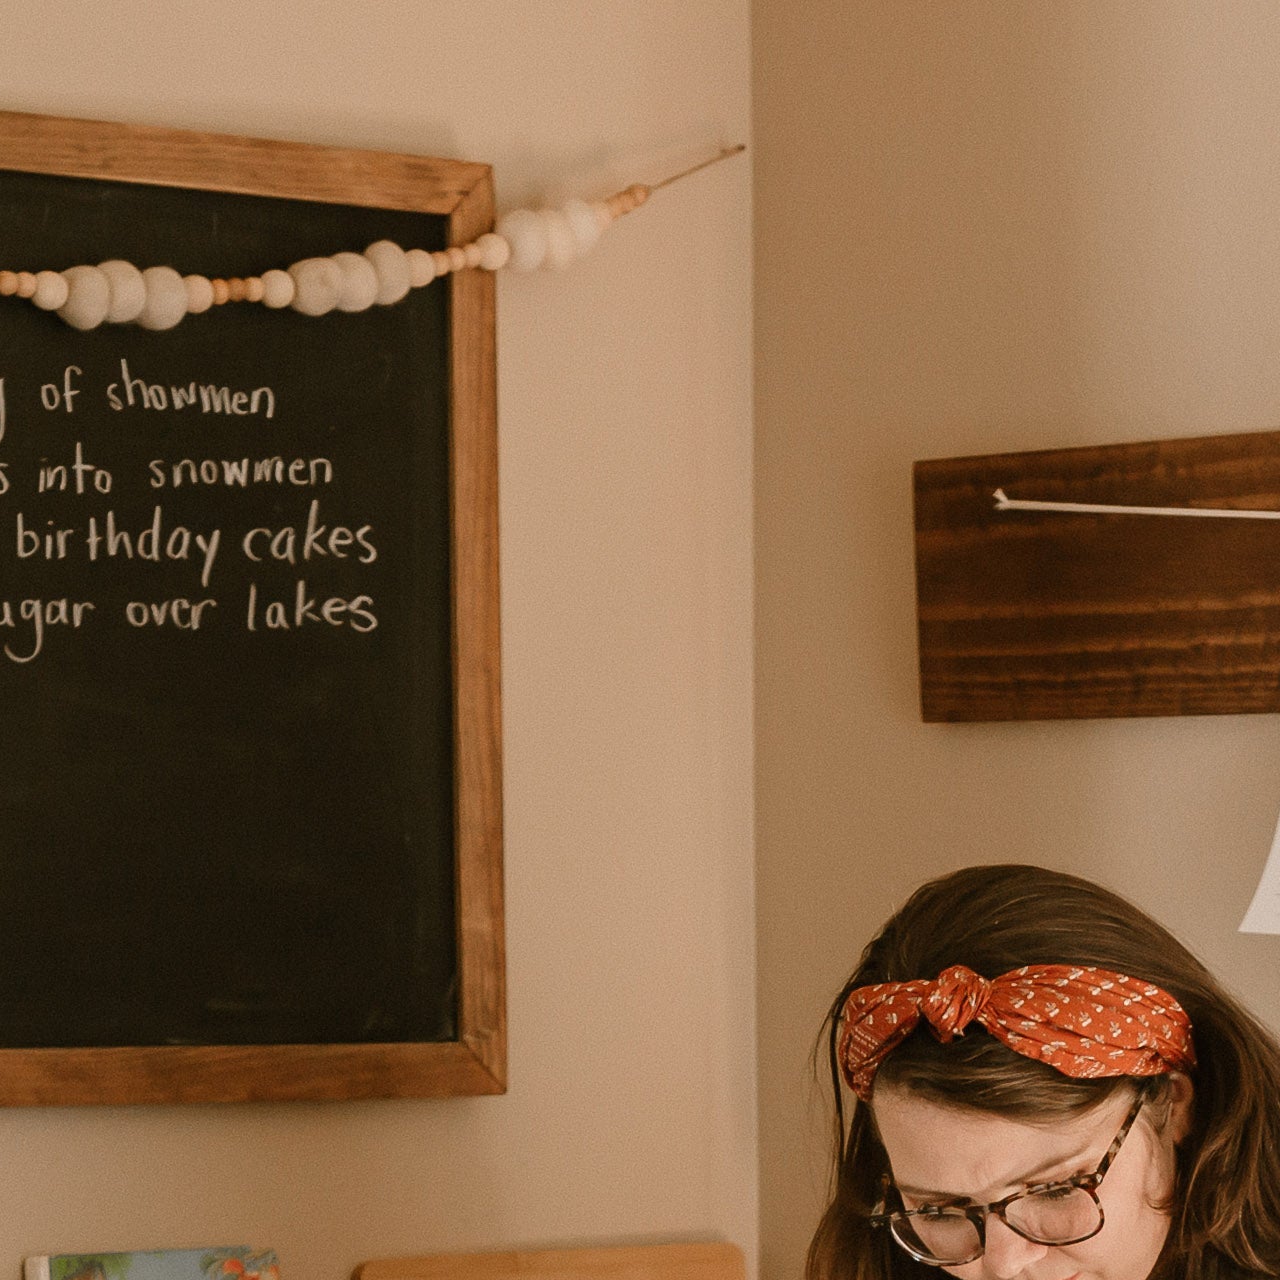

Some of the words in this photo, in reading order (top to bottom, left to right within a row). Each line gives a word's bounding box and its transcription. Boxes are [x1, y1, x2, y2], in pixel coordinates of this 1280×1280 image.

[40, 365, 82, 413] of
[106, 358, 276, 419] showmen
[38, 441, 113, 495] into
[149, 455, 333, 487] snowmen
[16, 505, 221, 587] birthday
[242, 499, 378, 565] cakes
[125, 598, 217, 631] over
[247, 579, 378, 633] lakes
